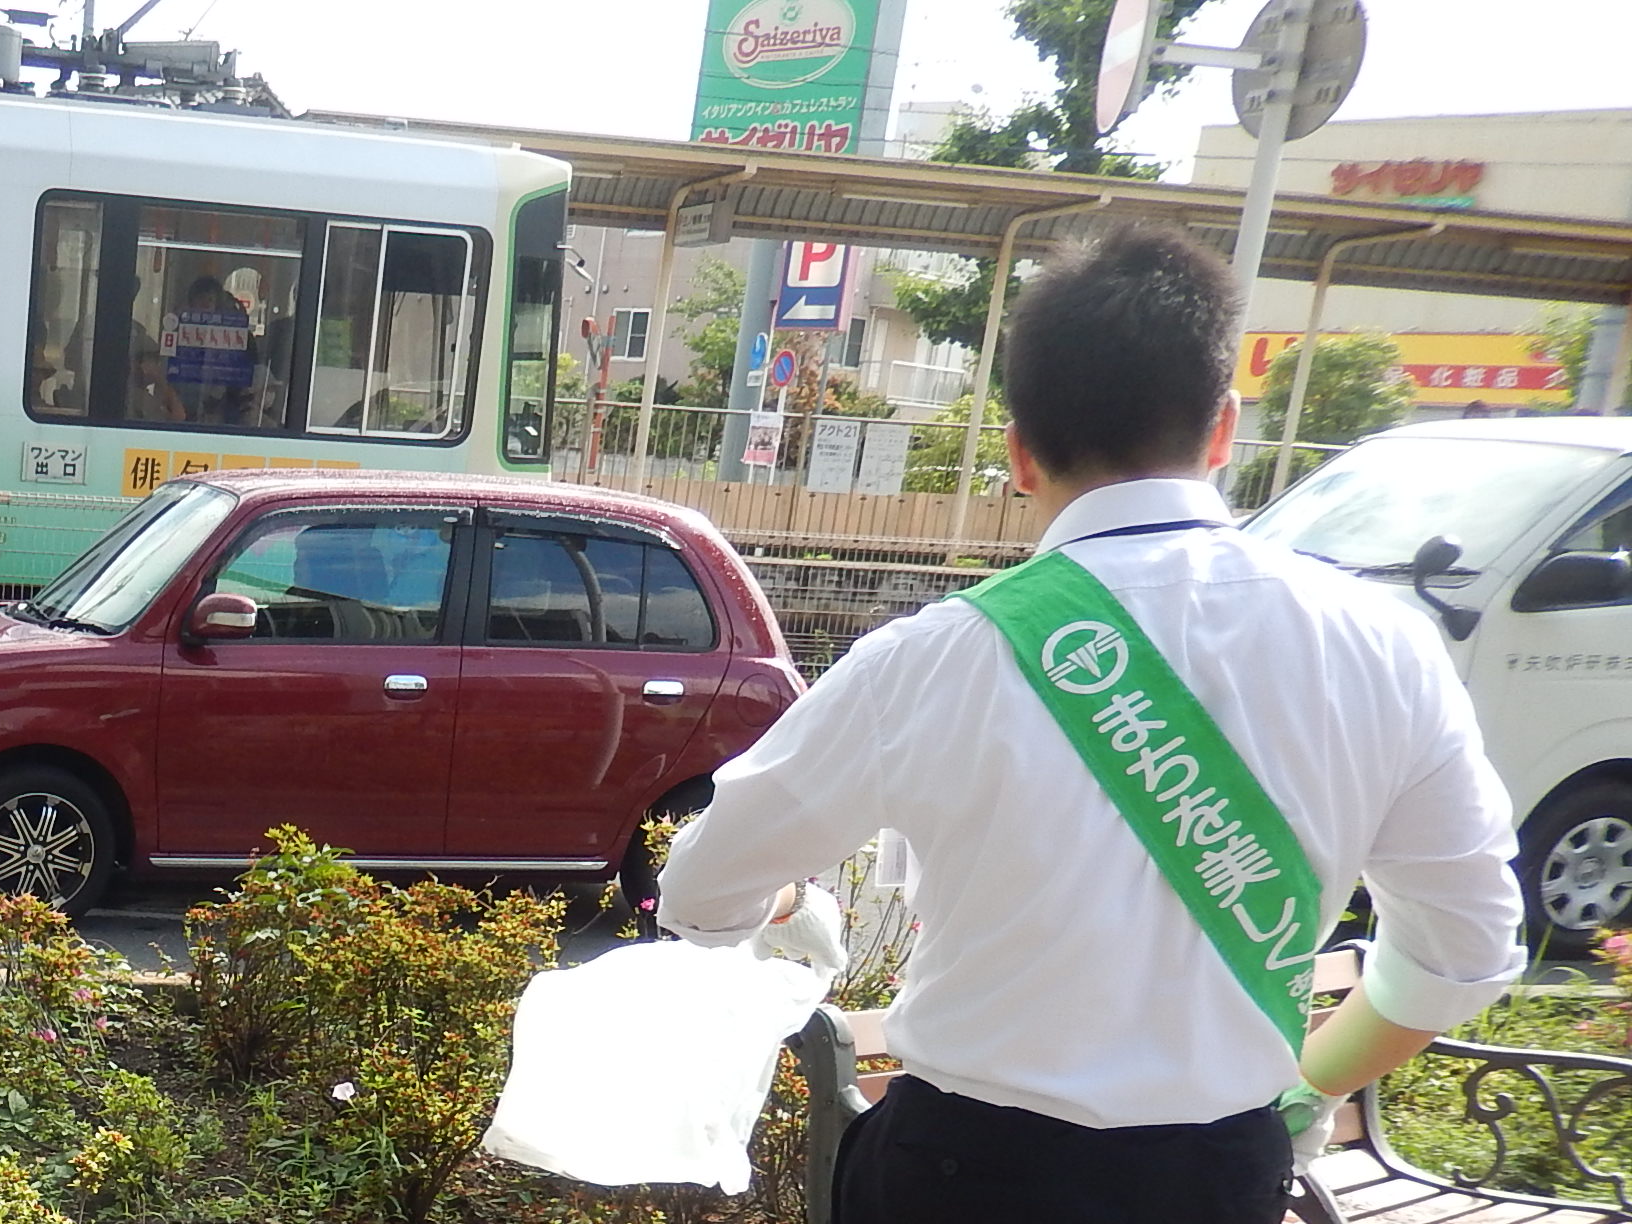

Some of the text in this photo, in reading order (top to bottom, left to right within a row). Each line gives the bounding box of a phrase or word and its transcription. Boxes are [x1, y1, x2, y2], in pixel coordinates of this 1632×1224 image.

[735, 19, 842, 60] Saizeriya
[798, 242, 837, 281] P
[1429, 367, 1518, 388] 化粧品
[818, 424, 858, 438] アクト21
[30, 446, 83, 461] ワンマン
[35, 461, 77, 477] 出口
[1091, 690, 1315, 971] まちを美しく
